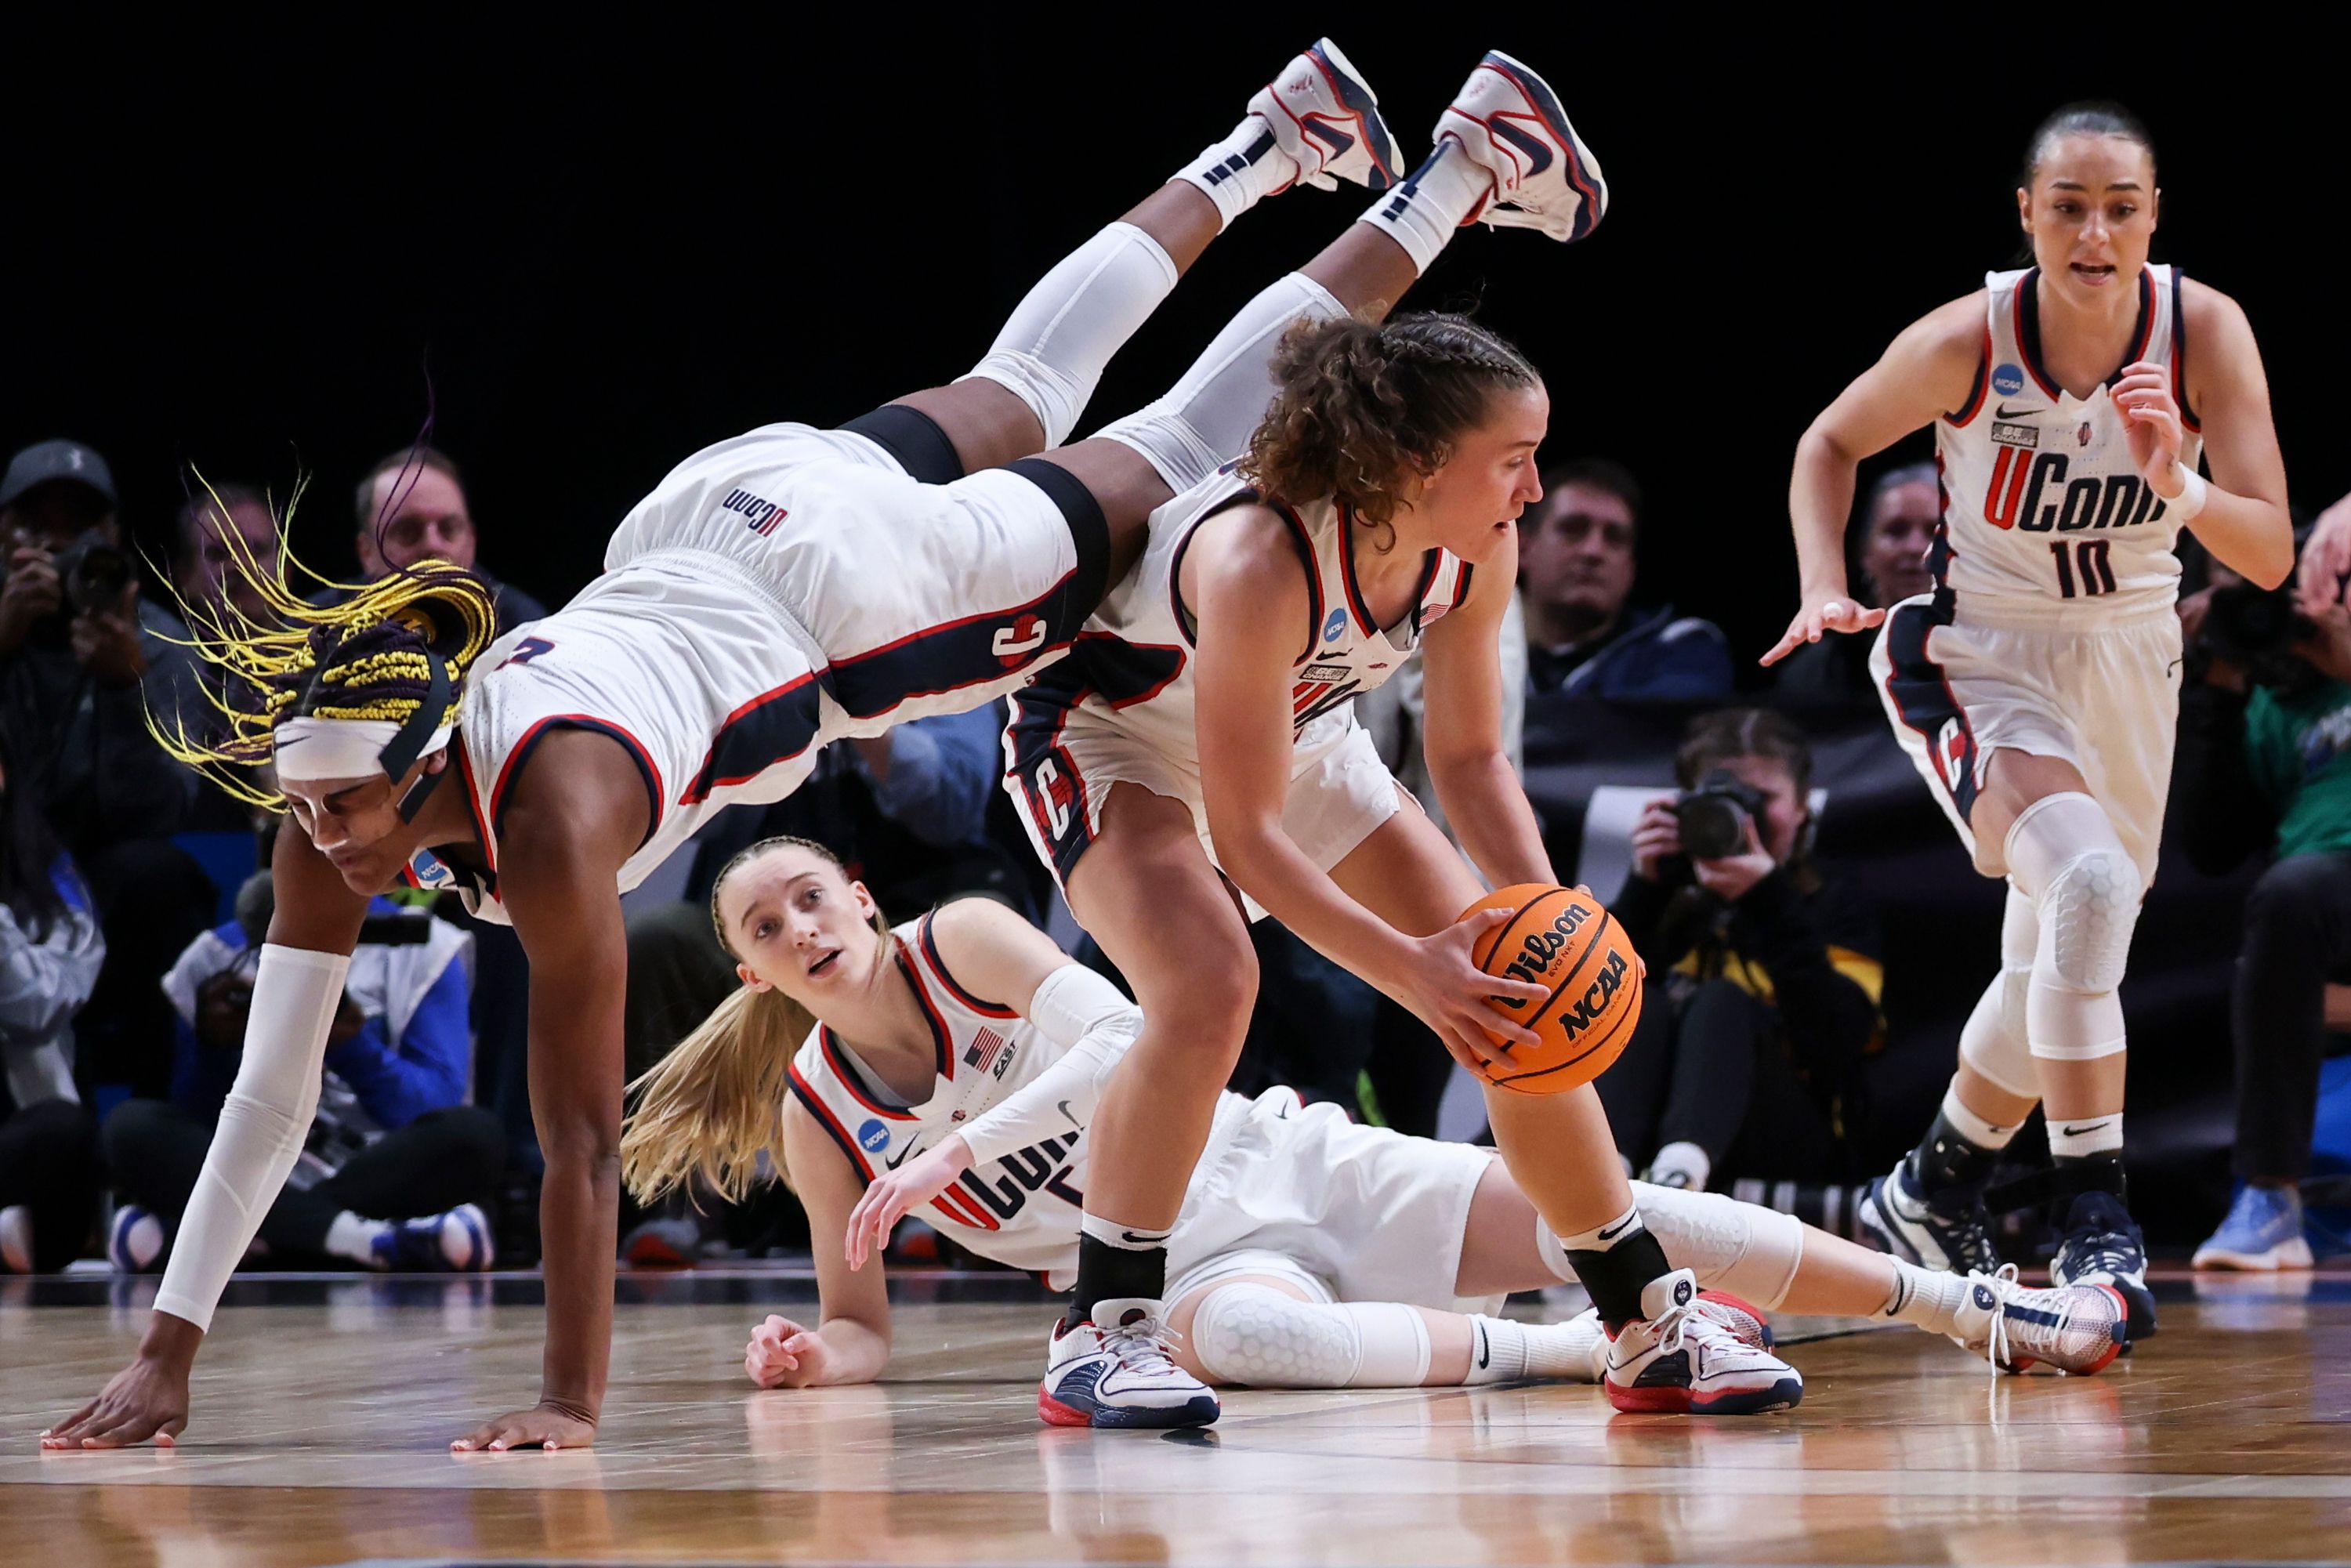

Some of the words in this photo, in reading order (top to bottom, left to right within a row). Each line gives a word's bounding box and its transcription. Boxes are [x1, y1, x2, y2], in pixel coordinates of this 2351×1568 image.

[1995, 378, 2021, 390] NCAA
[723, 488, 788, 538] UConn
[2049, 539, 2117, 598] 10
[1326, 621, 1345, 637] NCAA
[421, 861, 443, 878] NCA
[1549, 959, 1563, 977] EVO
[1561, 940, 1575, 958] NXT
[1558, 947, 1628, 1042] NCAA
[1572, 1019, 1604, 1049] OFFICIAL
[1606, 992, 1622, 1016] GAME
[865, 1128, 889, 1150] NCAA
[929, 1126, 1085, 1231] UCo
